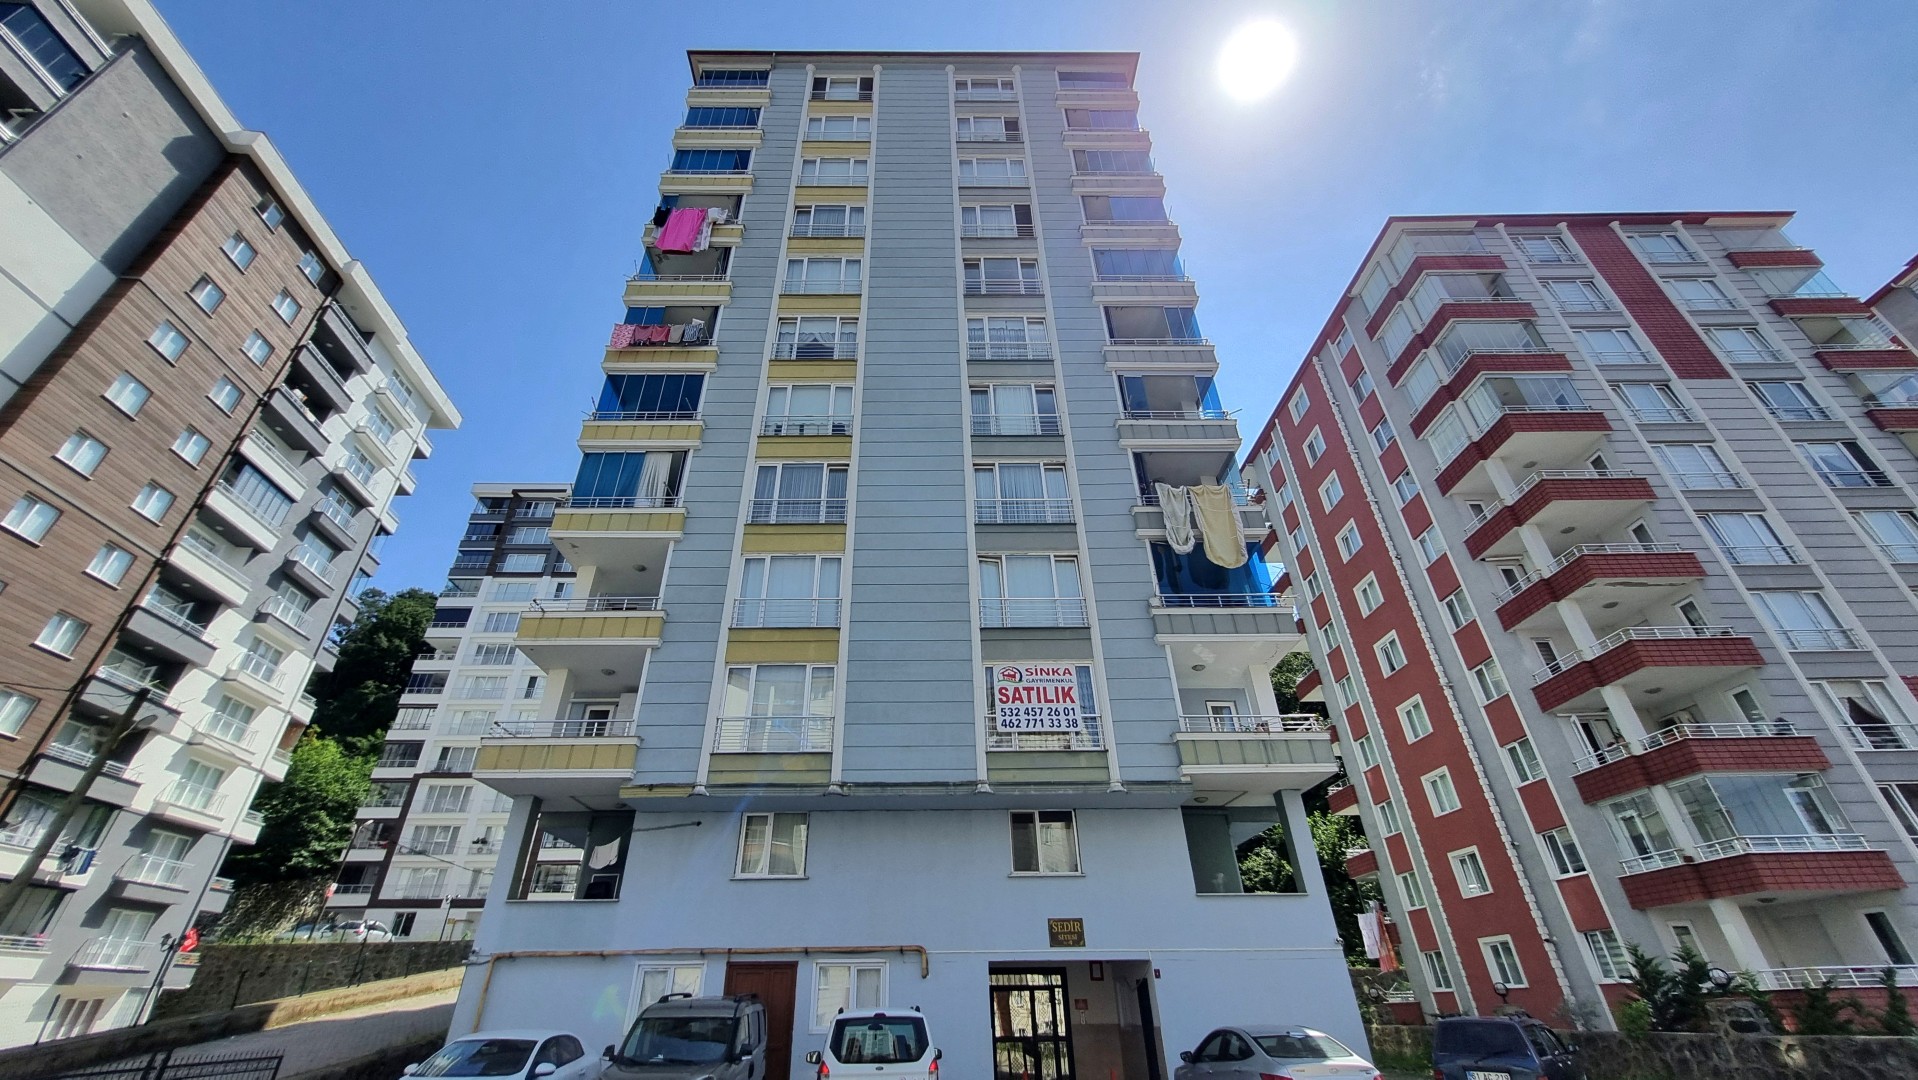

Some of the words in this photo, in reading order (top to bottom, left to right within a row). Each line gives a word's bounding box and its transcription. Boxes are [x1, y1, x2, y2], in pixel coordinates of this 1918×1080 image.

[1025, 665, 1073, 676] SİNKA
[998, 686, 1076, 704] SATILIK
[1001, 707, 1020, 716] 532
[1024, 707, 1043, 716] 457
[1046, 707, 1061, 716] 26
[1063, 707, 1076, 716] 01
[1001, 718, 1021, 728] 462
[1025, 718, 1044, 728] 771
[1048, 718, 1062, 728] 33
[1065, 718, 1078, 728] 38
